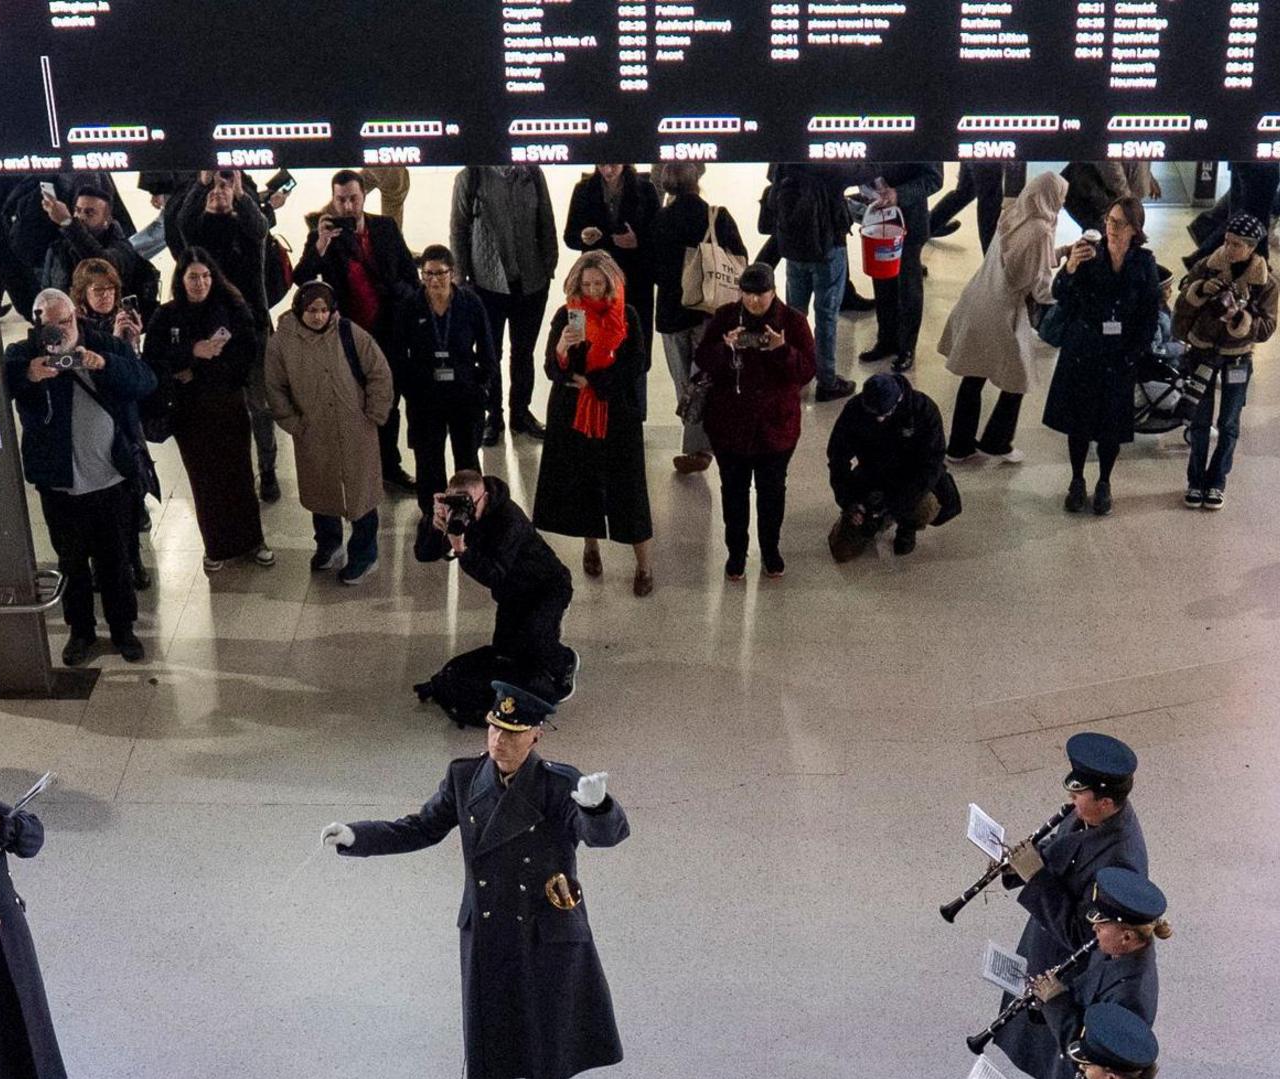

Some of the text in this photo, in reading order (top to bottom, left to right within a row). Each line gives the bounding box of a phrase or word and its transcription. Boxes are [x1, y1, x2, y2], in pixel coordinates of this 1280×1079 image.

[232, 149, 273, 166] SWR
[379, 147, 420, 163] SWR
[527, 145, 568, 161] SWR
[676, 143, 717, 159] SWR
[824, 142, 866, 158] SWR
[973, 142, 1016, 158] SWR
[1123, 141, 1165, 158] SWR
[87, 152, 128, 169] SWR
[707, 270, 733, 284] TOTE
